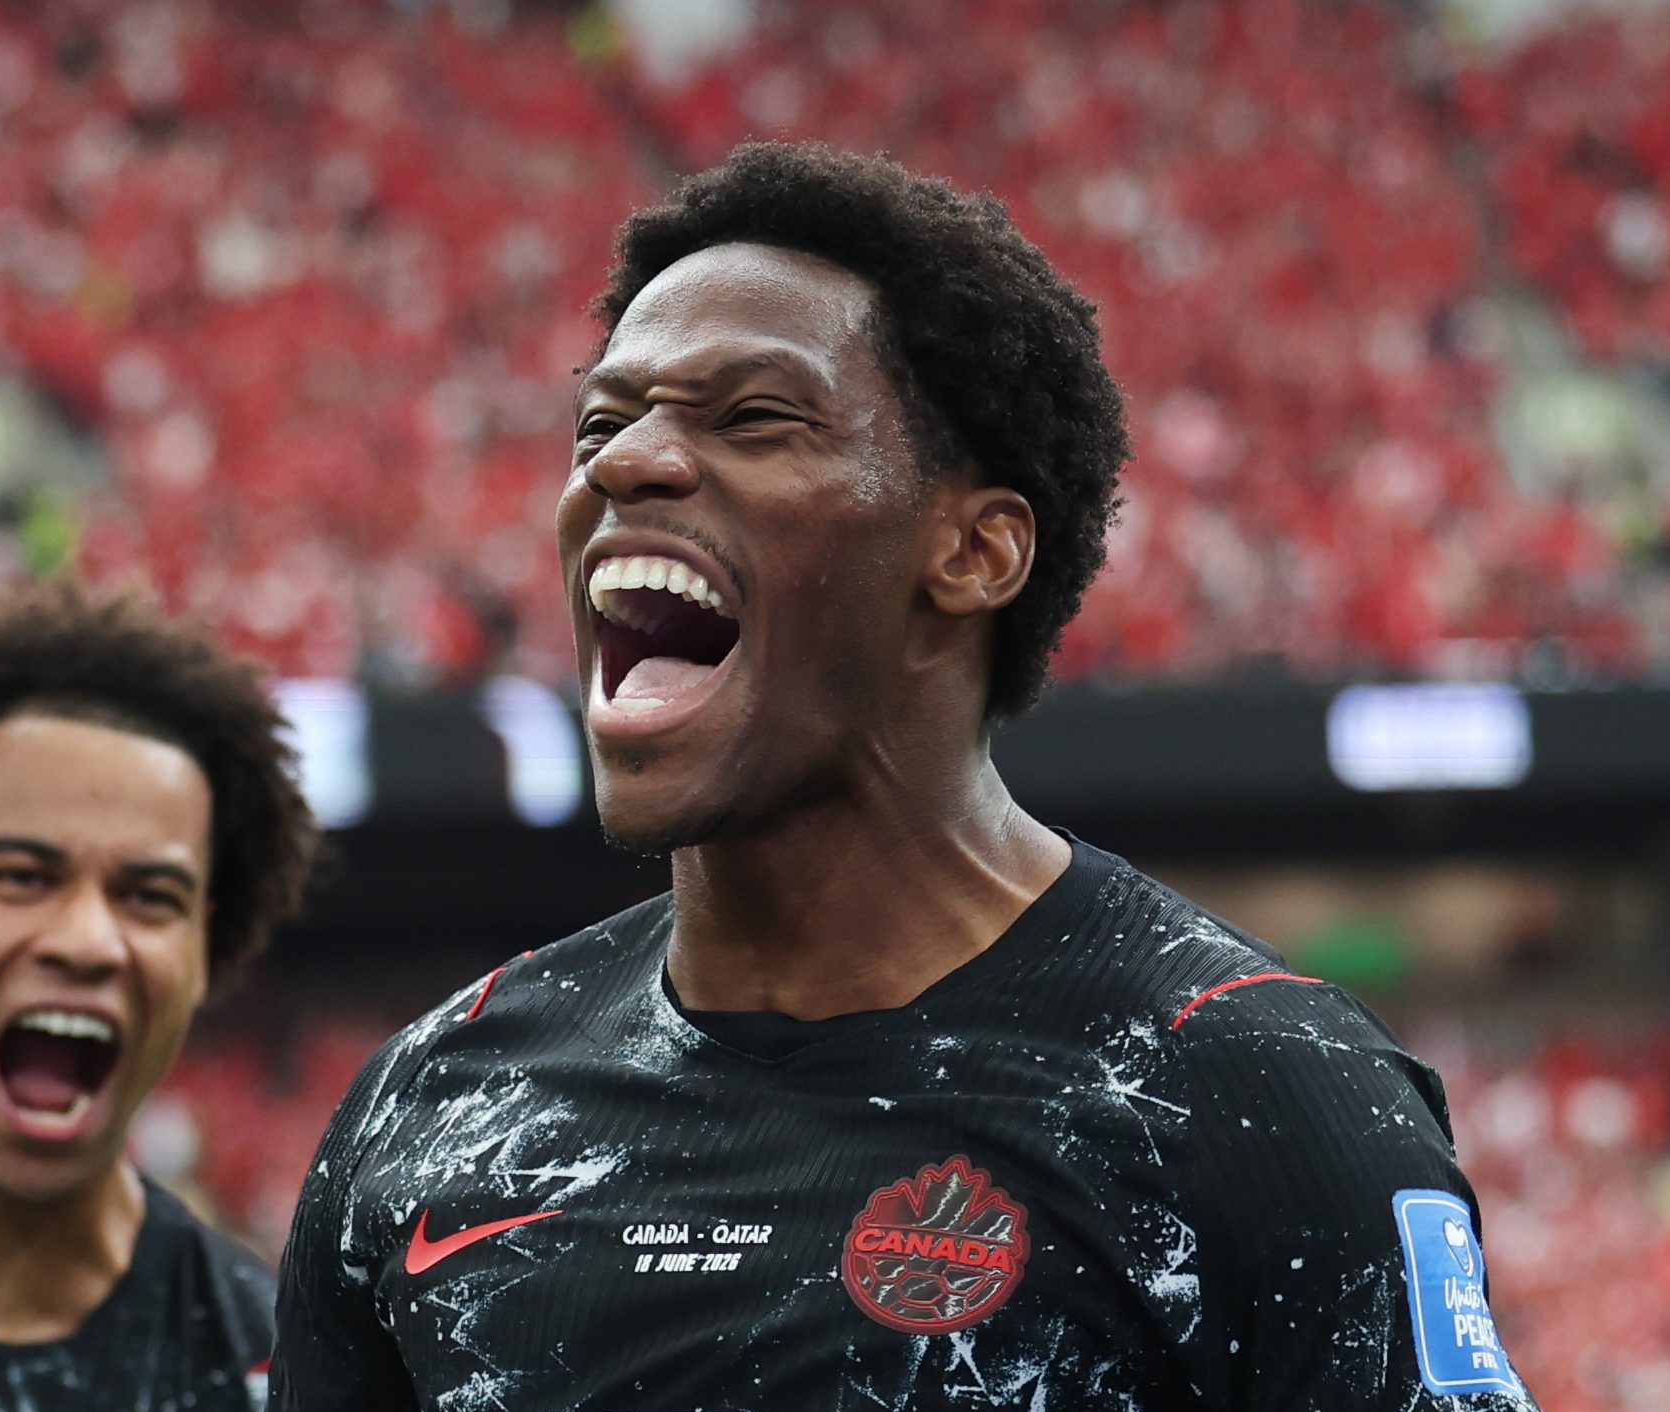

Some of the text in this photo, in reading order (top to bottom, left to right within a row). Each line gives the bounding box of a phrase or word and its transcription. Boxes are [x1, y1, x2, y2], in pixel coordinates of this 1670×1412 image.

[623, 1224, 688, 1244] CANADA
[712, 1224, 773, 1244] QATAR
[854, 1227, 1013, 1273] CANADA
[634, 1253, 742, 1272] 18 JUNE 2026
